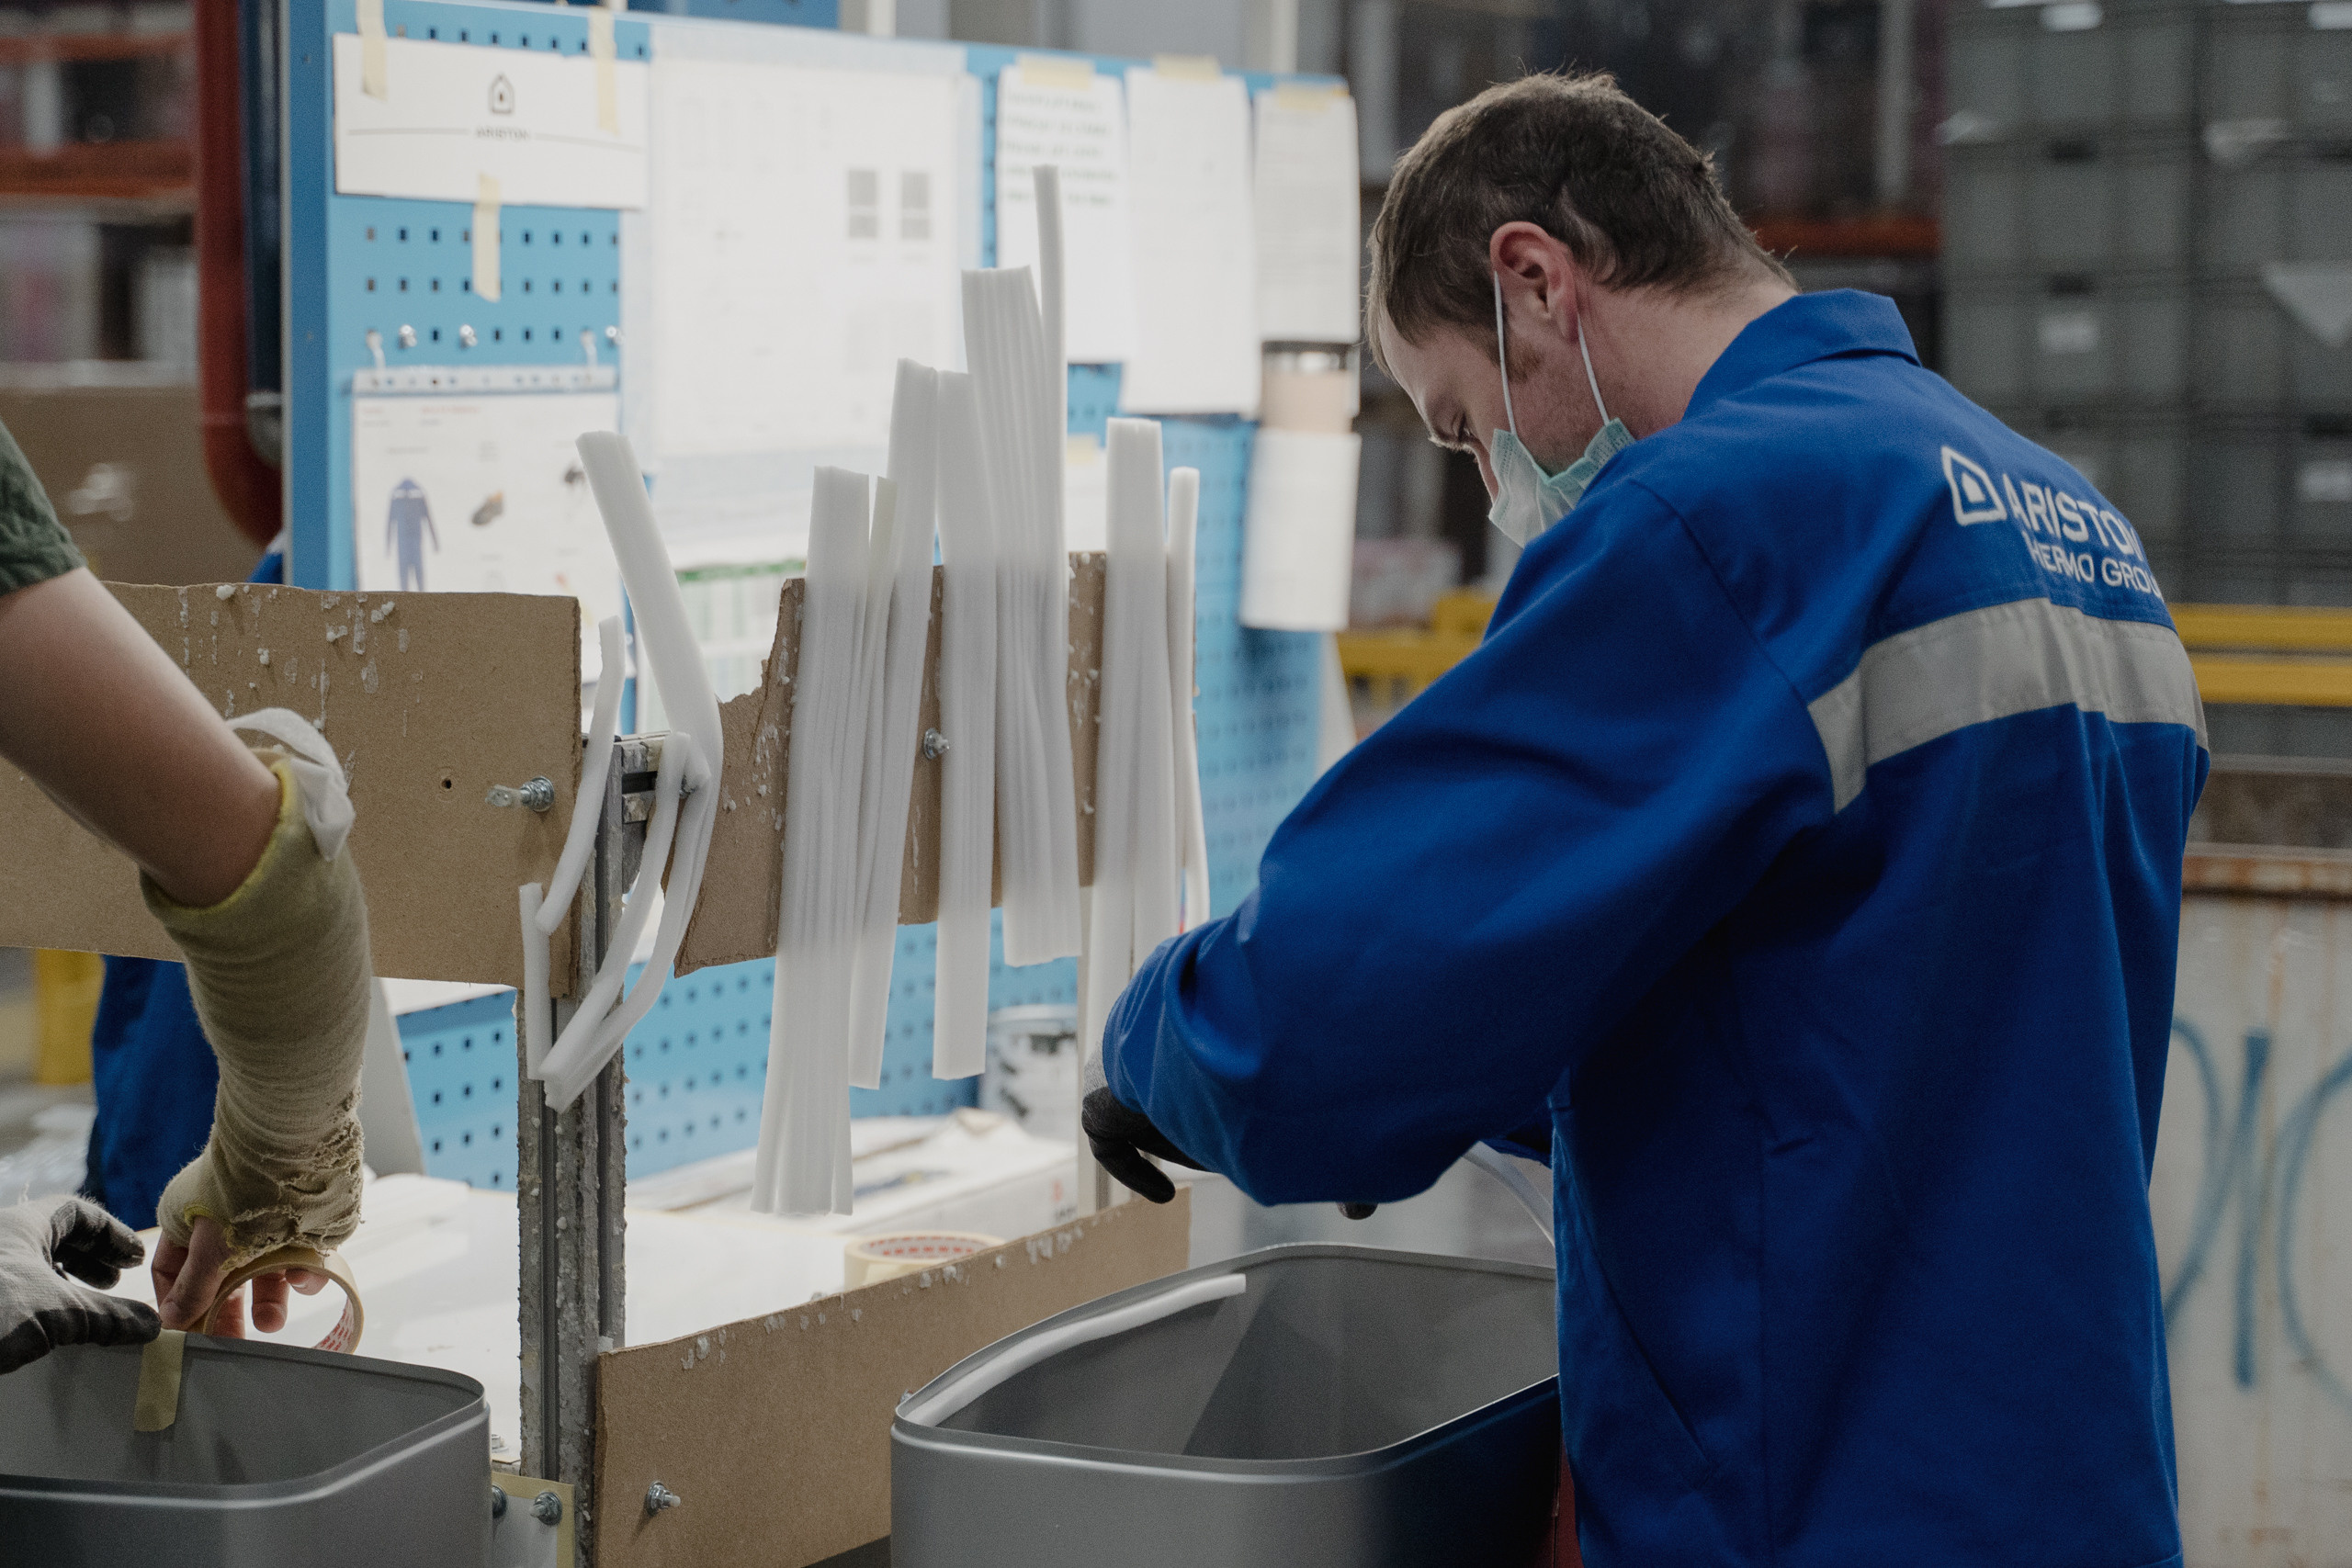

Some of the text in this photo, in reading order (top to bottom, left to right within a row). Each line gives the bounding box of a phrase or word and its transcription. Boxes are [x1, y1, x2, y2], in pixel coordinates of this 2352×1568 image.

[2002, 473, 2144, 562] ARISTON
[2022, 530, 2165, 604] HERMO GROU
